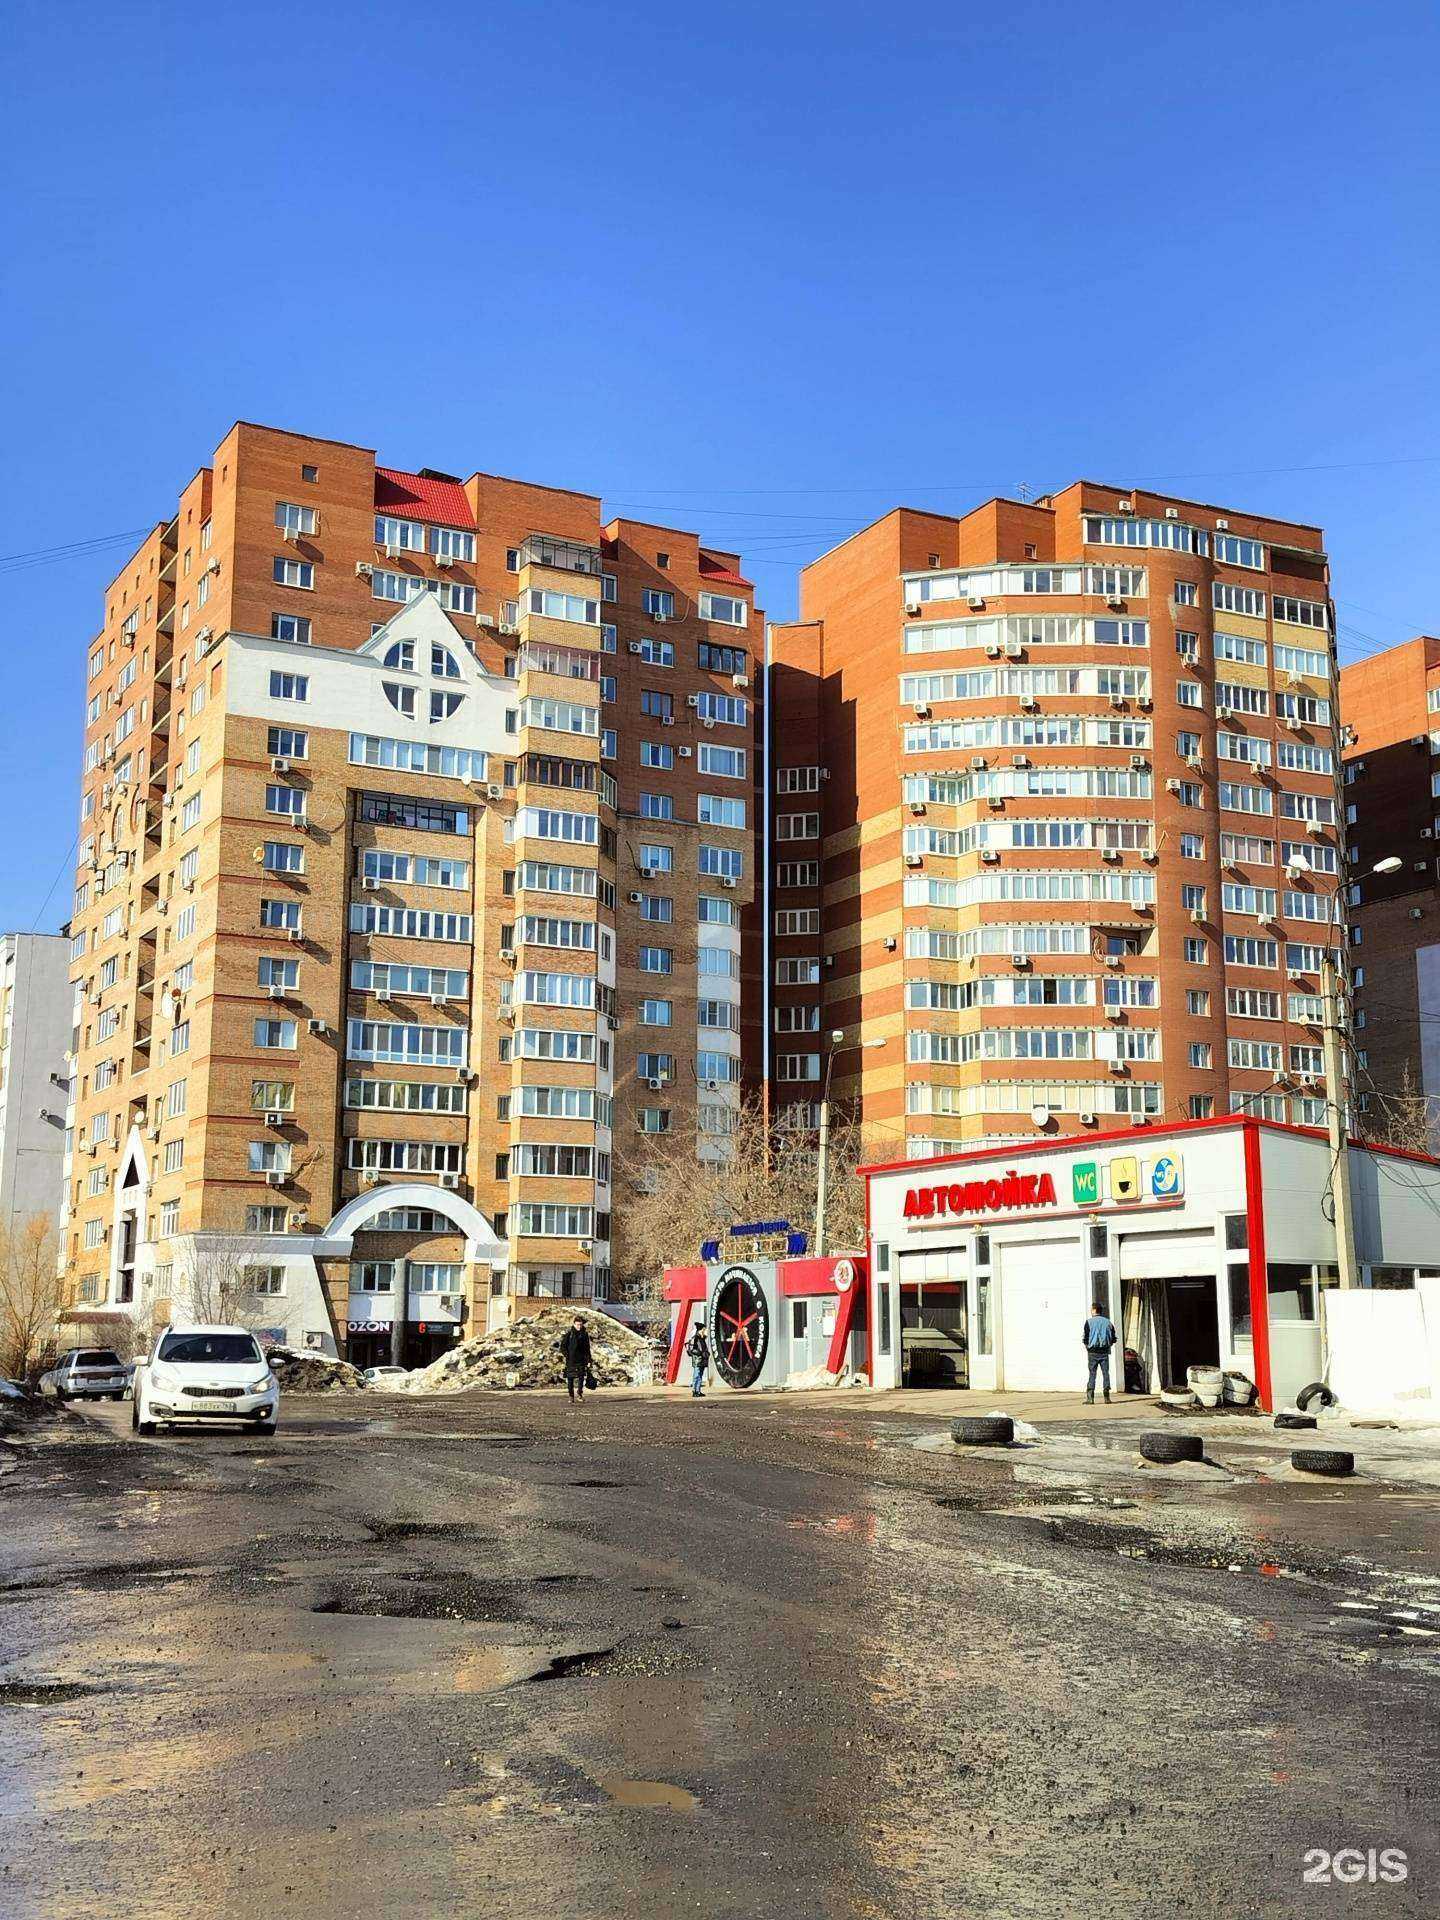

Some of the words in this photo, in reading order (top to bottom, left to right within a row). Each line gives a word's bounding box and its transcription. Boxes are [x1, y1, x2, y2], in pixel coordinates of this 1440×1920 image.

[1074, 1173, 1096, 1193] WC
[903, 1170, 1058, 1217] АВТОМОЙКА
[347, 1321, 390, 1332] OZON
